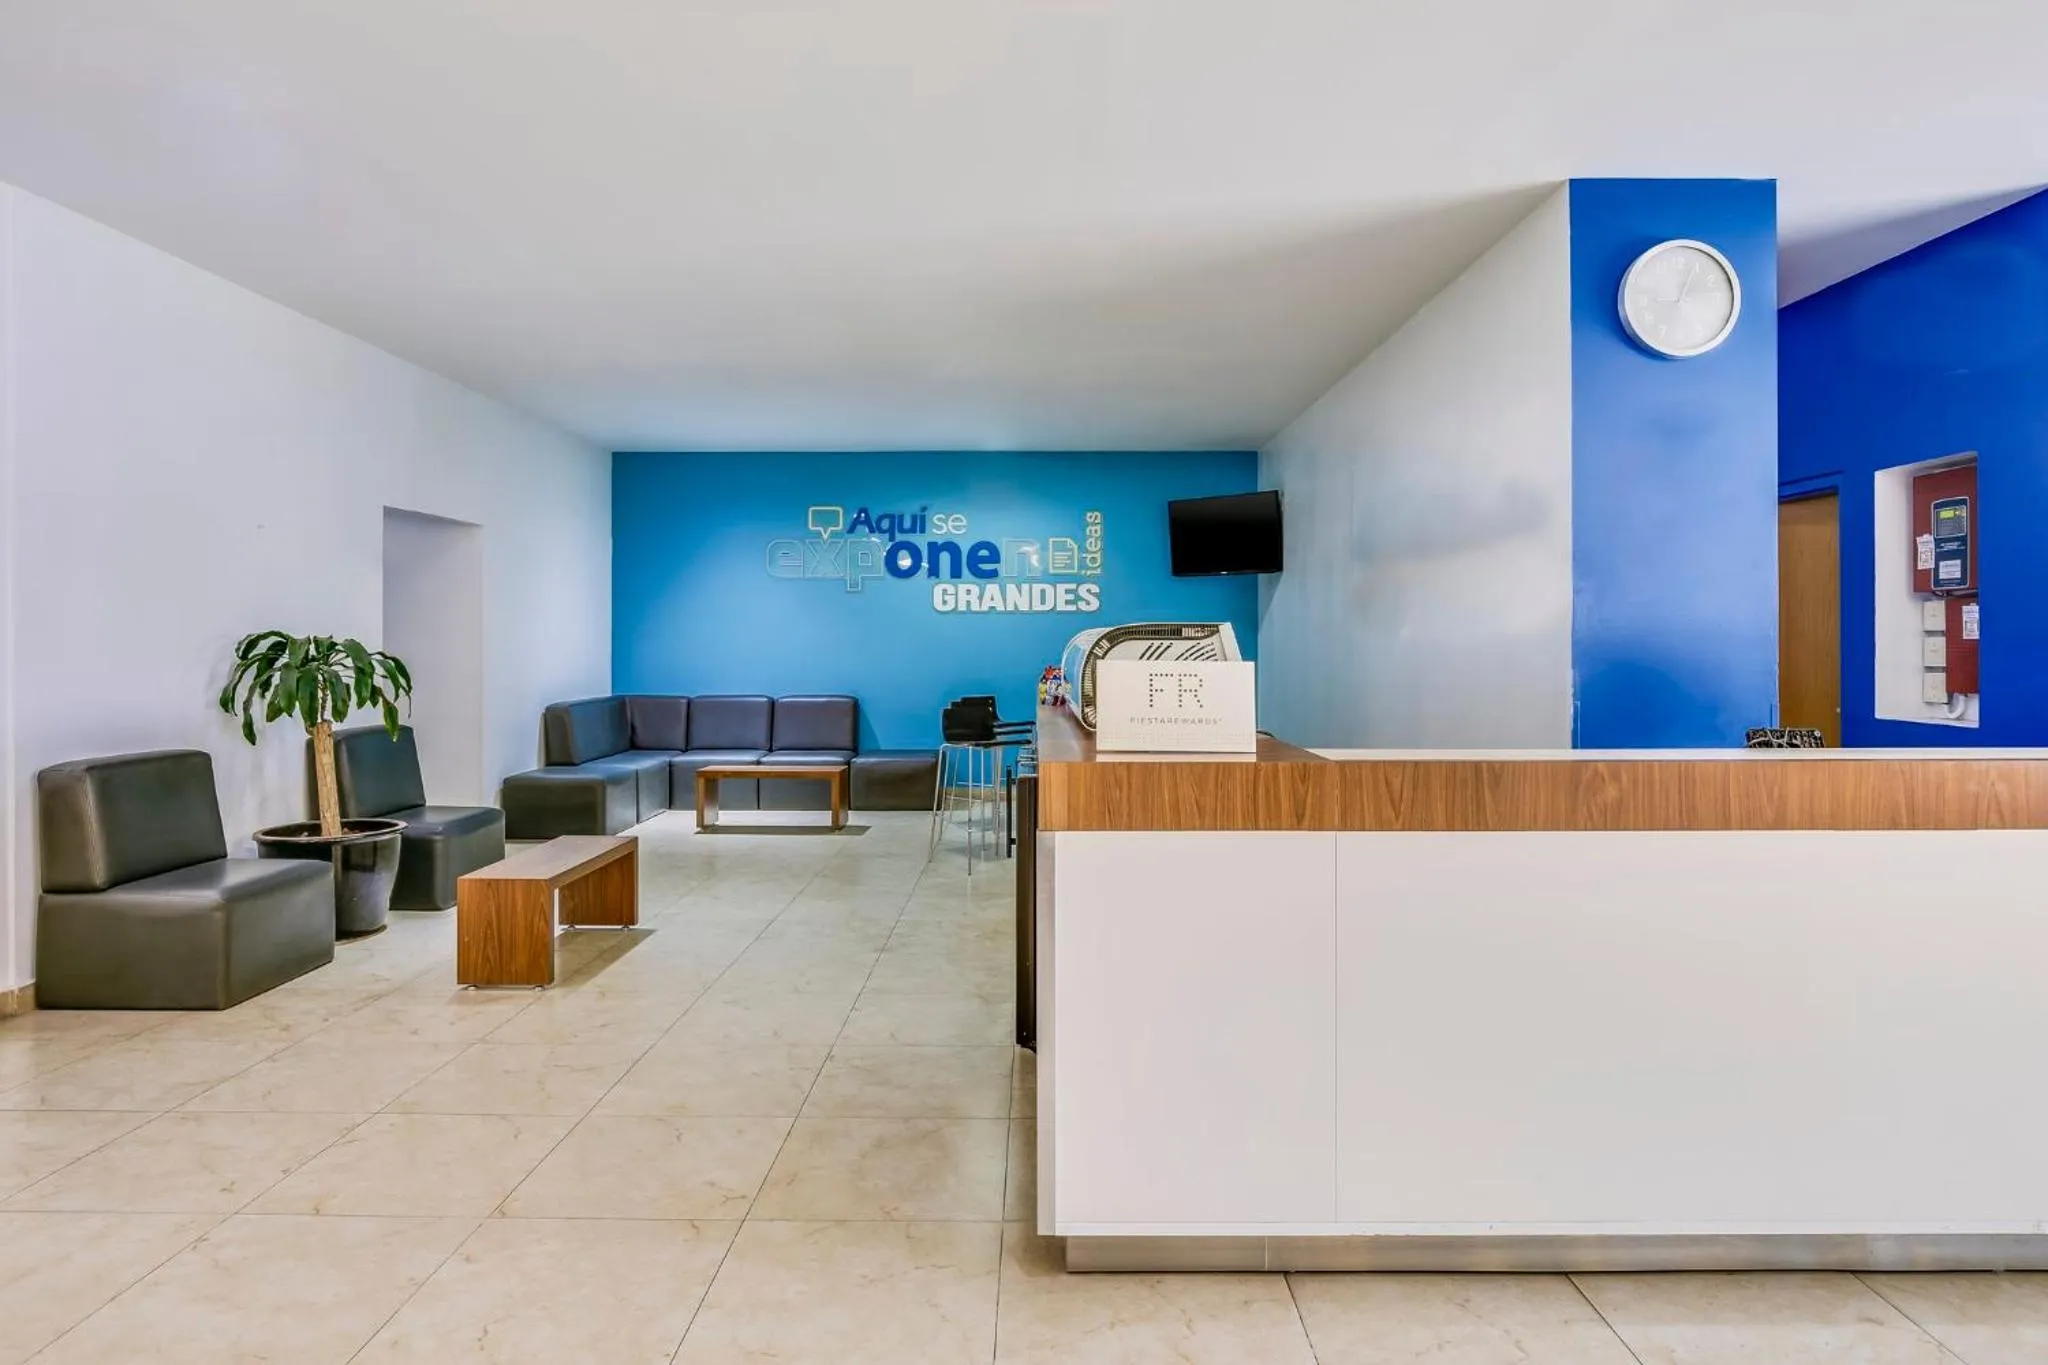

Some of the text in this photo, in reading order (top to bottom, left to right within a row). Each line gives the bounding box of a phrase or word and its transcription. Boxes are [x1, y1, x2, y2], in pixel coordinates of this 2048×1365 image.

[847, 506, 968, 542] Aquí se
[1081, 511, 1104, 577] ideas
[766, 538, 1043, 592] exponen
[932, 583, 1101, 612] GRANDES
[1148, 672, 1204, 709] FR
